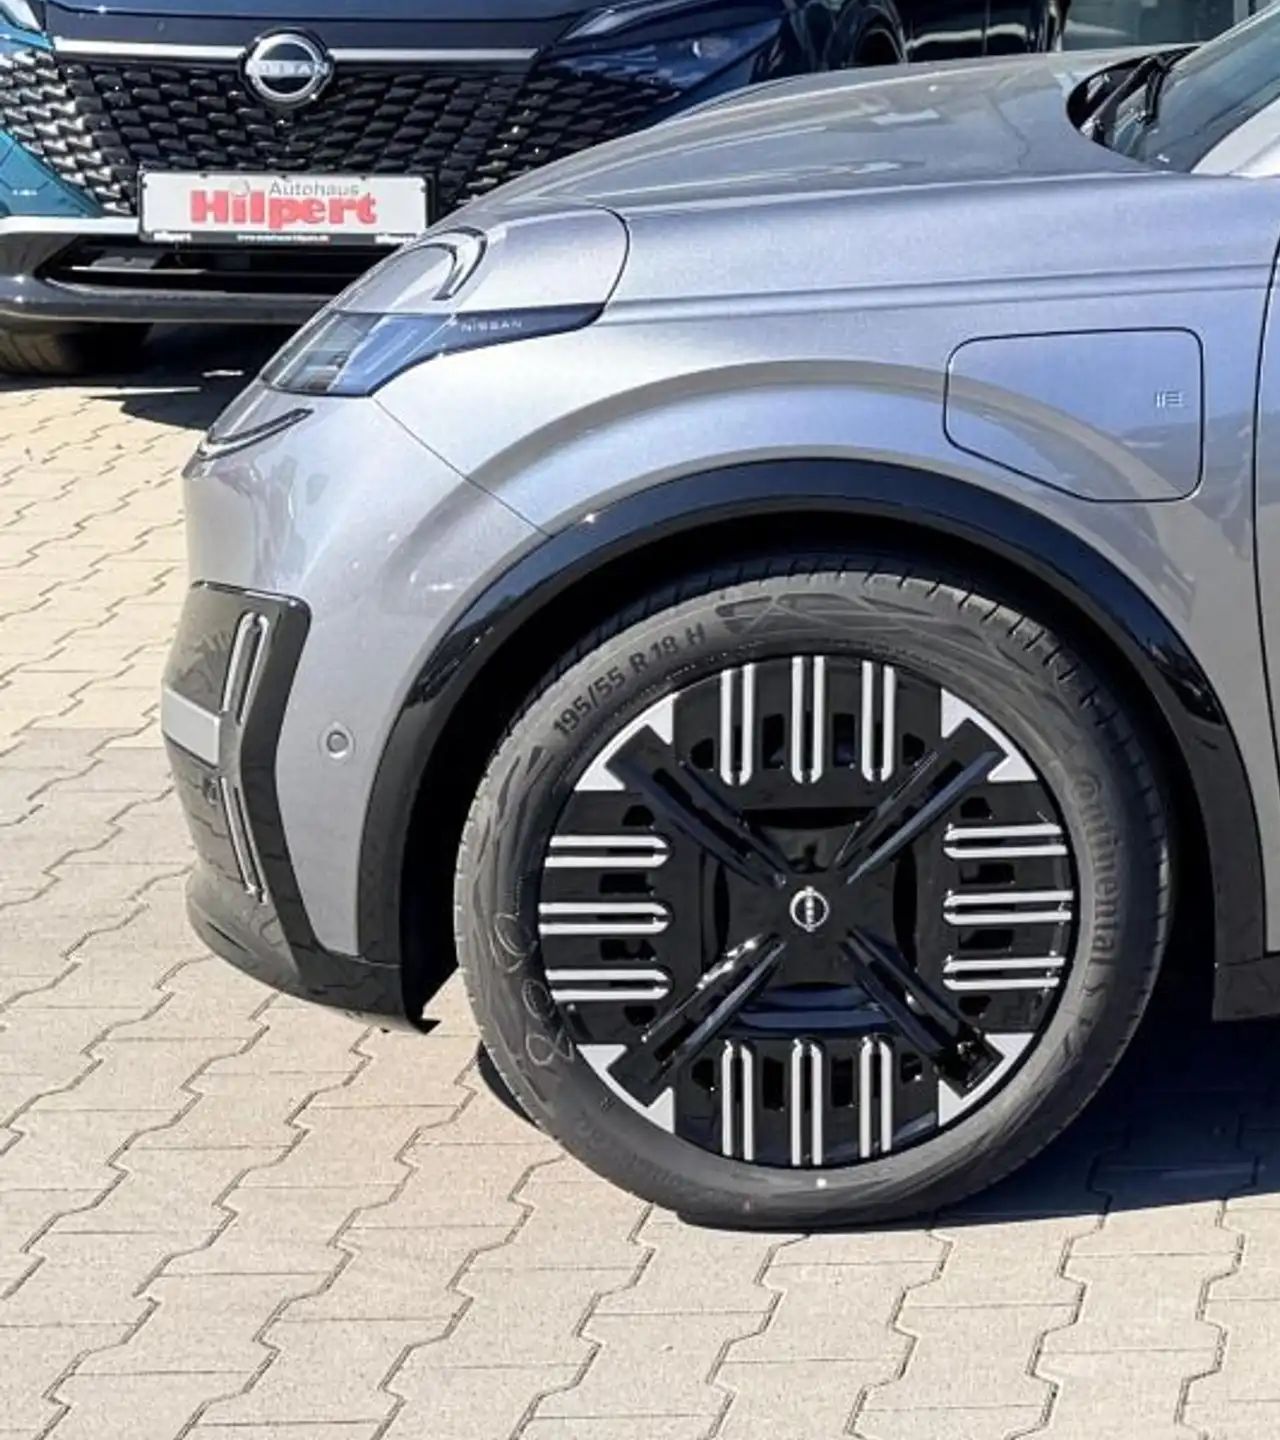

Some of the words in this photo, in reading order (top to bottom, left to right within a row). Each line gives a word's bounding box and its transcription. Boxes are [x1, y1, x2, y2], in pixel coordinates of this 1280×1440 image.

[190, 188, 379, 230] Hilpert
[269, 180, 360, 197] Autohaus
[460, 318, 523, 333] NISSAN
[553, 666, 626, 737] 195/55
[628, 651, 650, 675] R
[649, 634, 679, 661] 18
[684, 622, 706, 646] H
[1068, 769, 1121, 967] Continental
